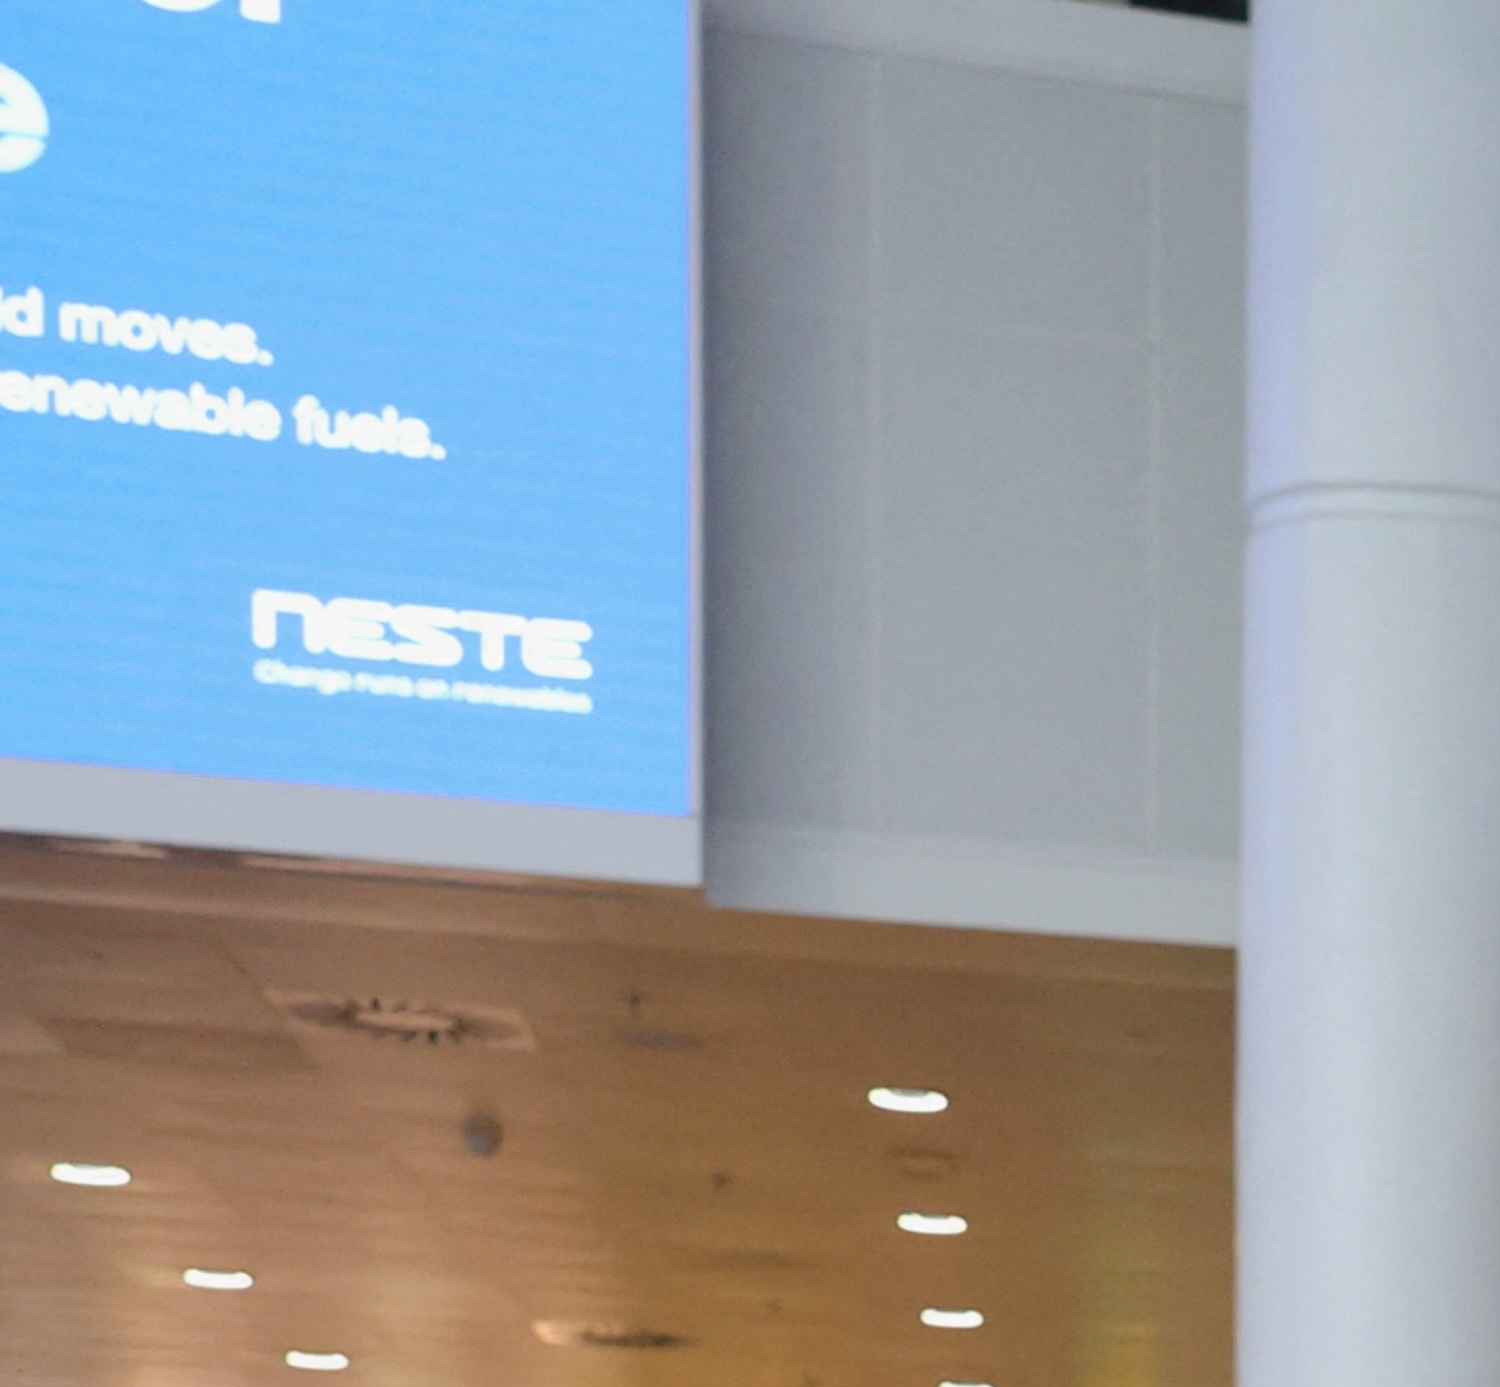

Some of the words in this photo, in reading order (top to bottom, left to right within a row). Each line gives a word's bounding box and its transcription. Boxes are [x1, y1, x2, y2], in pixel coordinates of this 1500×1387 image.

[58, 301, 274, 366] moves.
[0, 369, 282, 440] enewable
[292, 394, 446, 460] fuels.
[252, 588, 593, 680] NESTE
